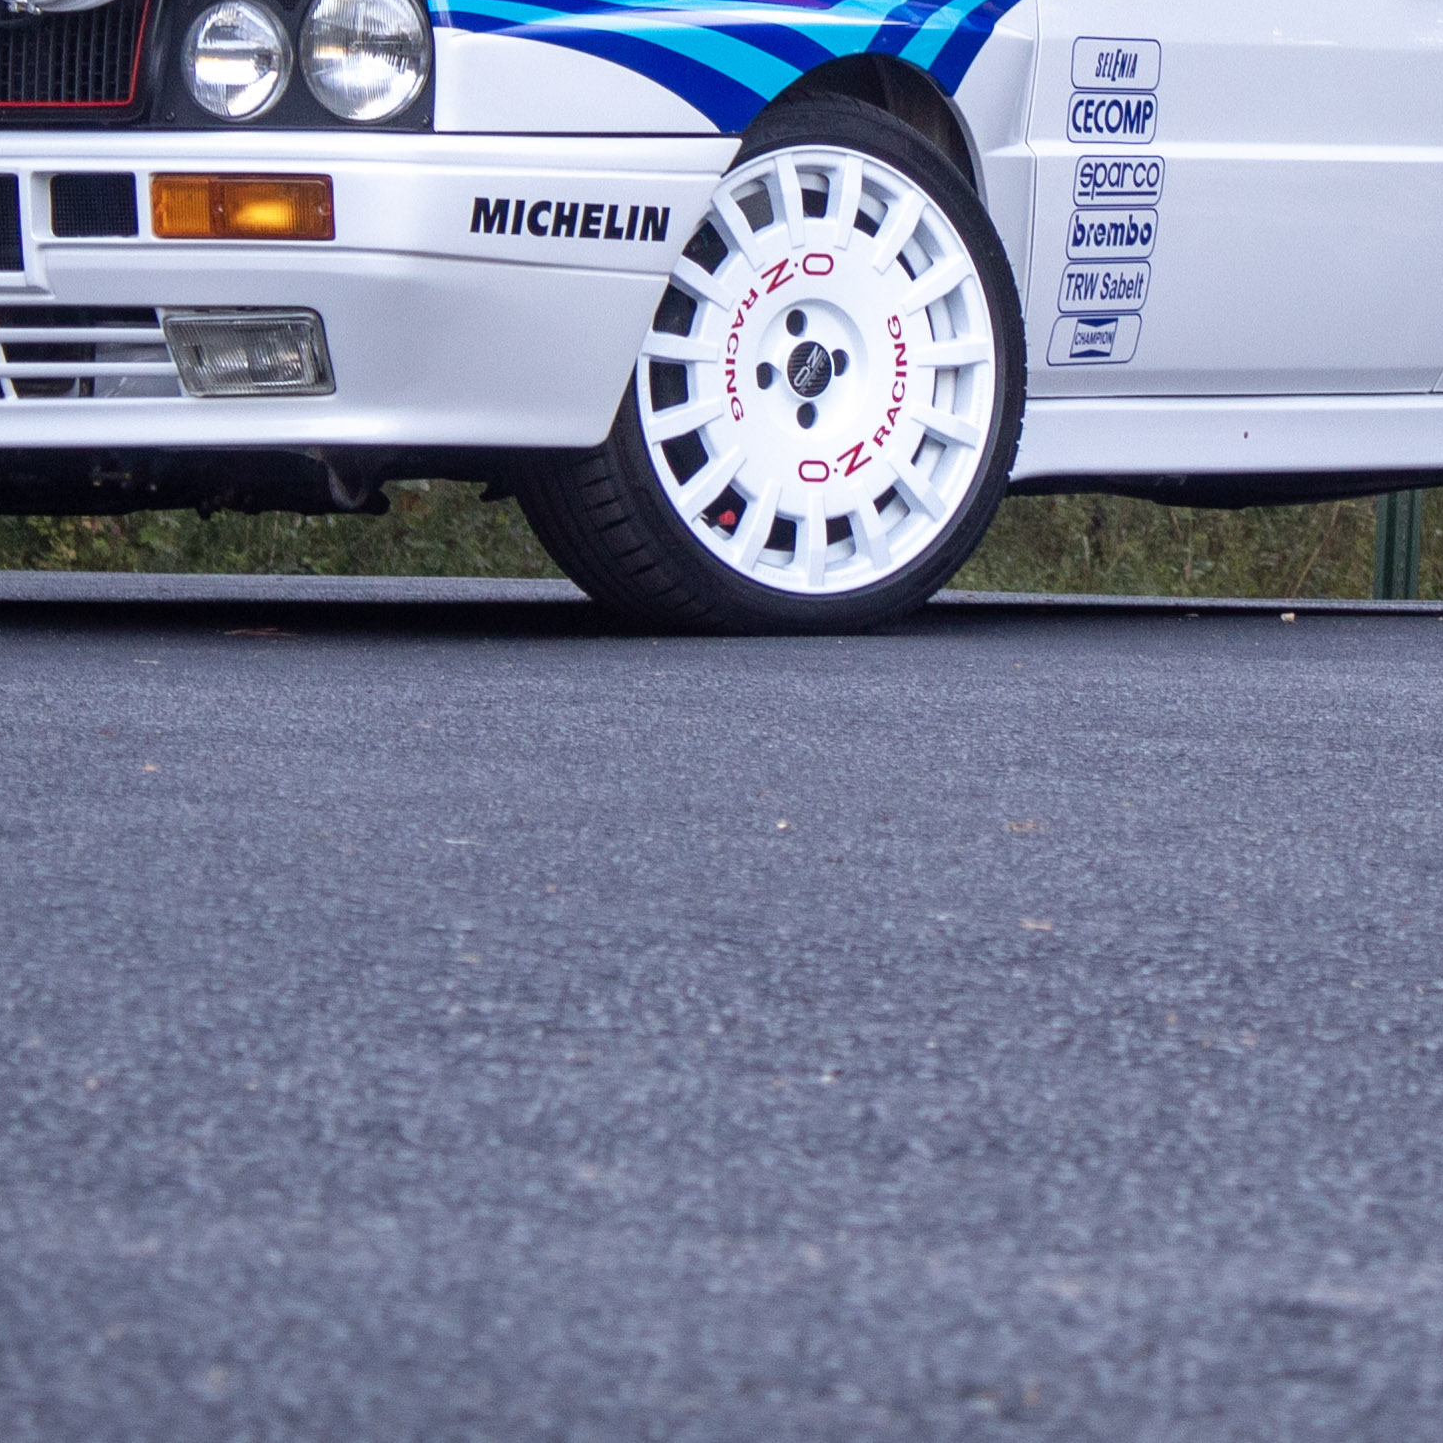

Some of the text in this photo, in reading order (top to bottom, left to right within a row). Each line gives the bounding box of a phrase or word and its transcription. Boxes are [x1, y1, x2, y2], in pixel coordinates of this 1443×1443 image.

[1095, 48, 1138, 82] SELENIA
[1071, 99, 1154, 134] CECOMP
[1079, 161, 1160, 201] sparco
[470, 197, 671, 242] MICHELIN
[1071, 213, 1153, 248] brembo
[1065, 271, 1144, 301] TRW Sabelt
[724, 287, 759, 422] RACING
[1074, 330, 1114, 346] CHAMPION
[872, 314, 908, 447] RACING
